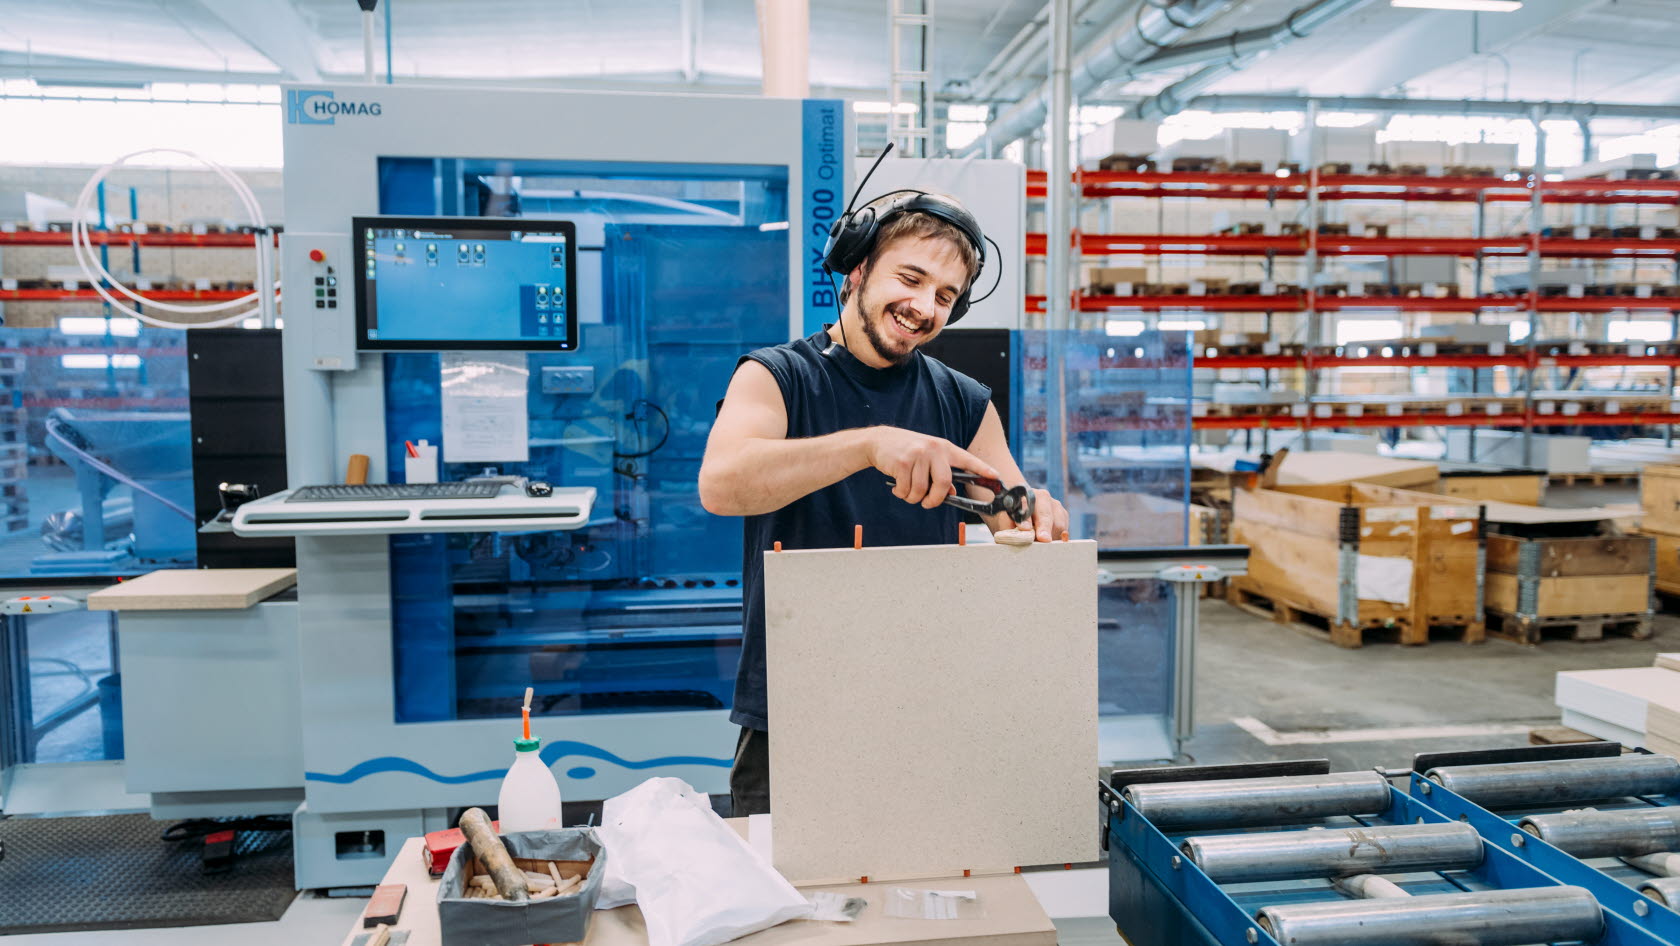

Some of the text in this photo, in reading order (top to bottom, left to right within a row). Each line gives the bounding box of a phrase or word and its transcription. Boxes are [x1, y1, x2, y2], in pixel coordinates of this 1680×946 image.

[314, 101, 382, 115] HOMAG
[817, 107, 838, 181] Optimat
[812, 188, 834, 237] 200
